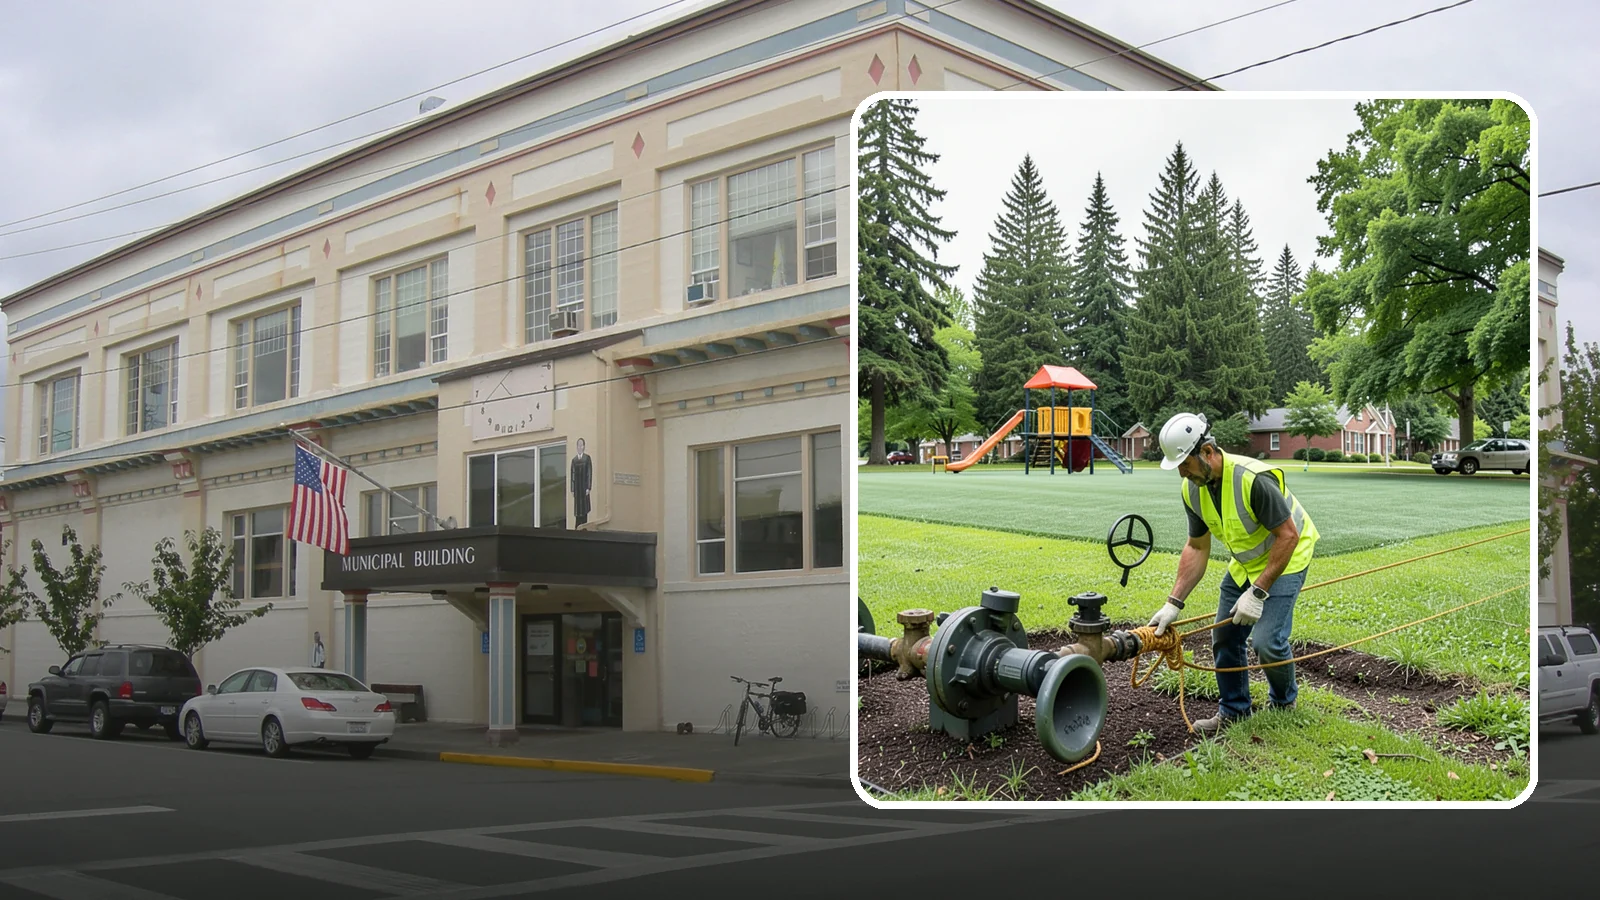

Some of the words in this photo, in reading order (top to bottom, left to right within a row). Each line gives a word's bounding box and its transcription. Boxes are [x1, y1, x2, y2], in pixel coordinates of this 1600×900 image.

[475, 390, 479, 398] 7
[536, 402, 540, 410] 4
[481, 407, 485, 415] 8
[488, 417, 492, 425] 9
[529, 414, 533, 422] 3
[495, 423, 500, 431] 10
[521, 420, 525, 428] 2
[501, 425, 506, 433] 11
[507, 425, 513, 433] 12
[342, 552, 405, 572] MUNICIPAL
[414, 546, 475, 567] BUILDING
